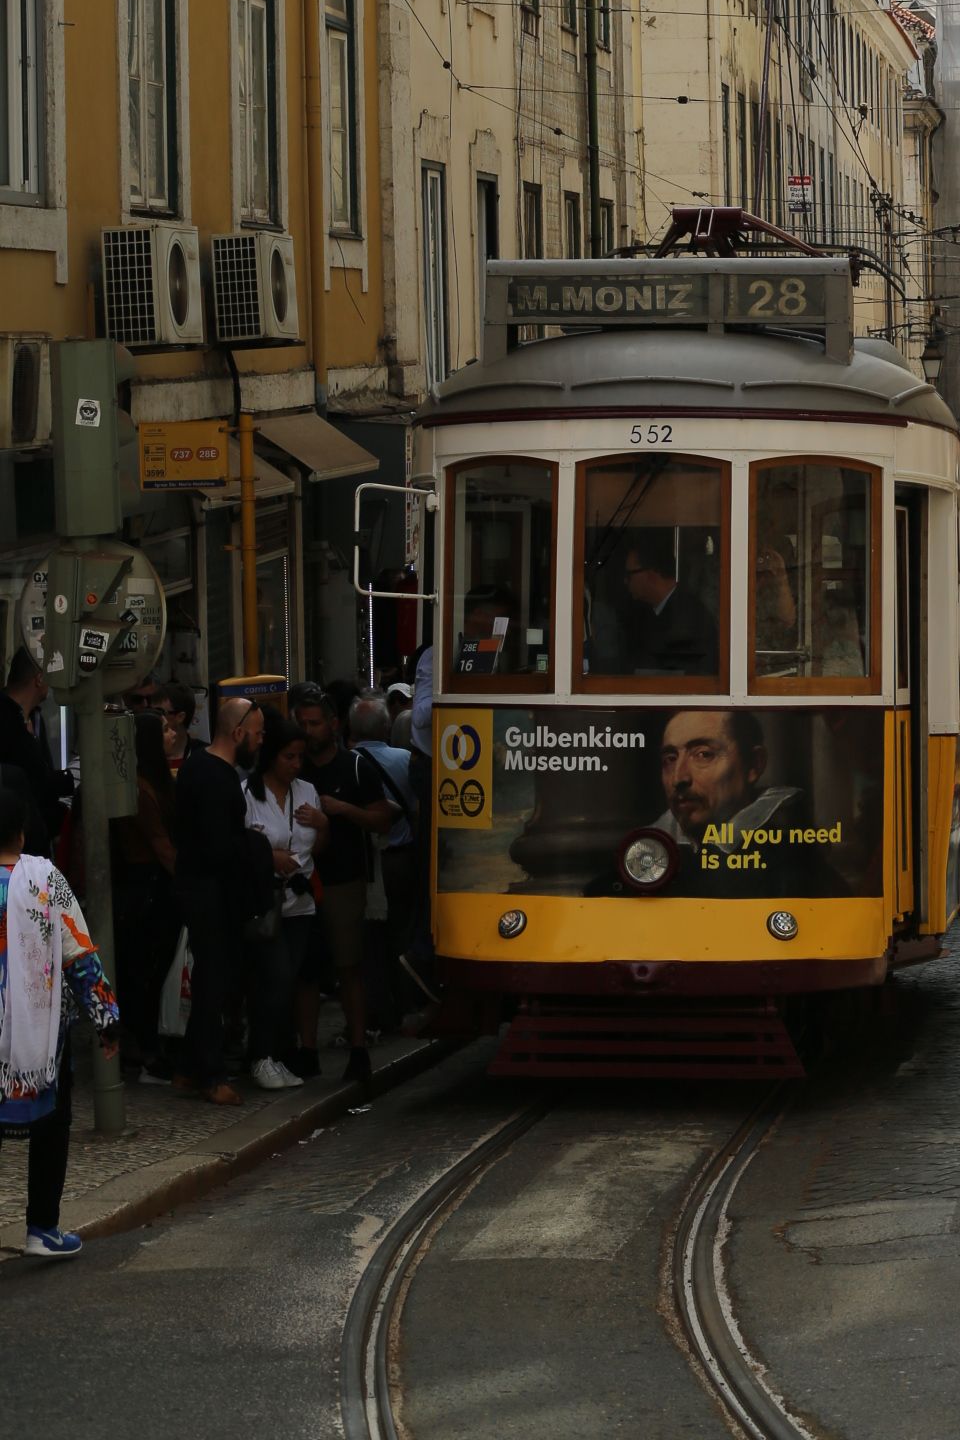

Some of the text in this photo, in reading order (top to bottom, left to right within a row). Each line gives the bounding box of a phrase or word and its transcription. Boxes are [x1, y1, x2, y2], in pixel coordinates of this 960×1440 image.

[749, 277, 807, 316] 28
[630, 424, 673, 444] 552
[173, 450, 190, 459] 737
[199, 449, 217, 458] 28E
[463, 643, 478, 652] 28E
[459, 659, 474, 672] 16
[504, 725, 646, 749] Gulbenkian
[503, 749, 609, 772] Museum.
[702, 822, 842, 850] All you need
[701, 849, 768, 870] is art.
